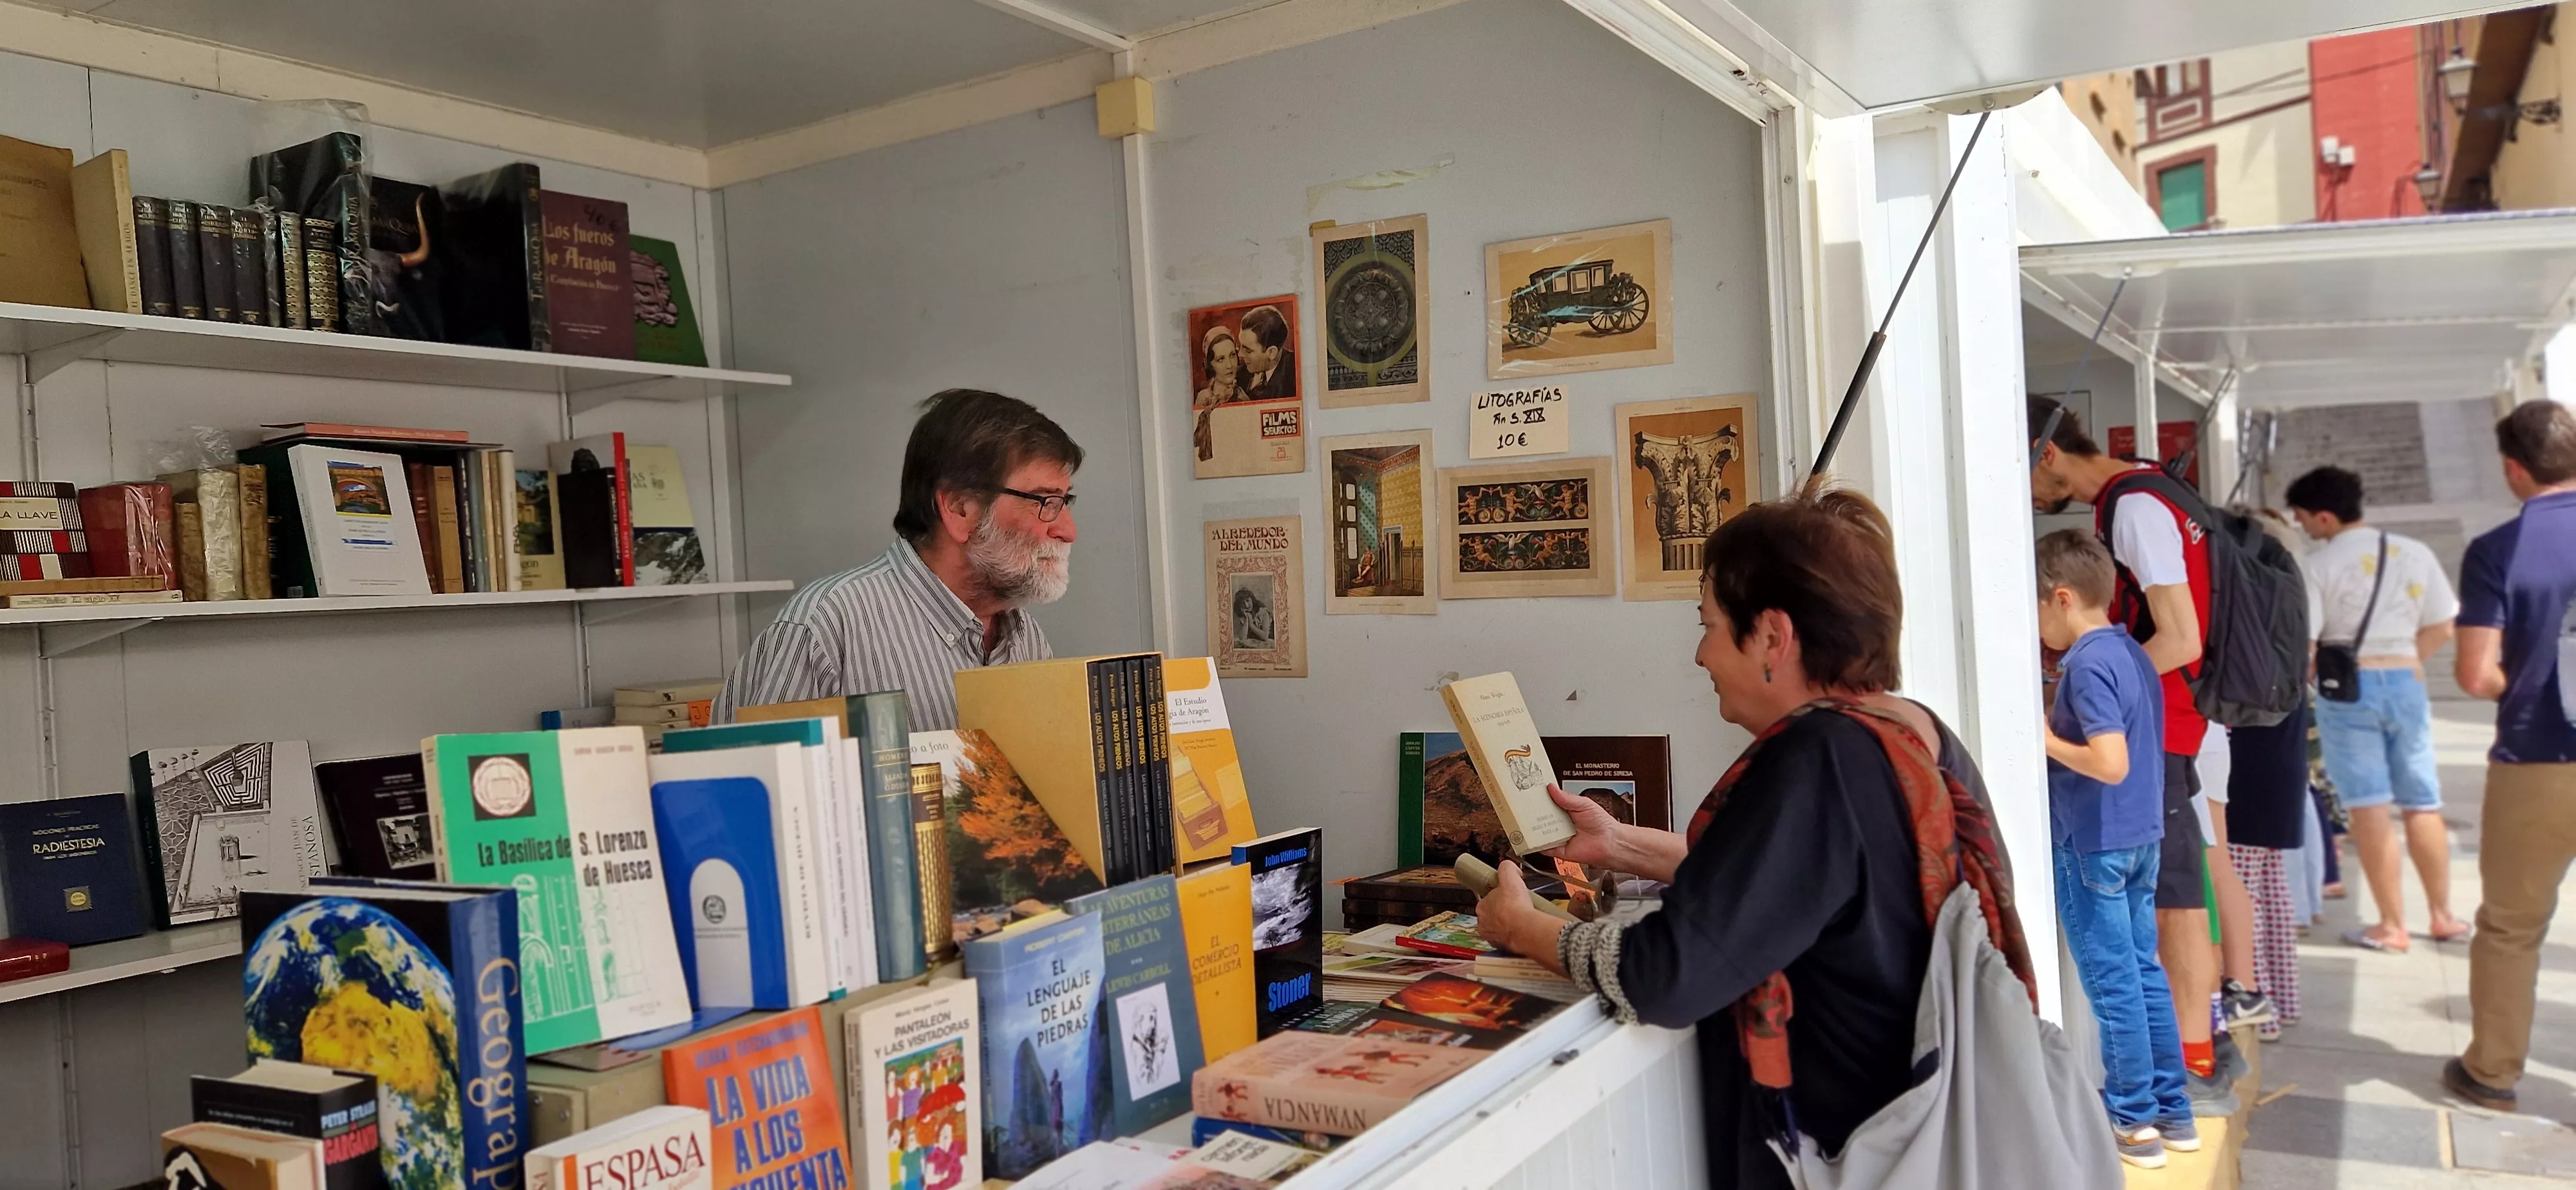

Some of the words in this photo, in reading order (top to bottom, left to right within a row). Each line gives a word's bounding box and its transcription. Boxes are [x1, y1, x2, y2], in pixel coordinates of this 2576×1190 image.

[573, 222, 615, 247] fueros
[563, 246, 616, 276] Aragón
[1263, 411, 1296, 426] FILMS
[1523, 407, 1546, 424] XIX
[1264, 425, 1296, 436] SELECTOS
[17, 511, 59, 520] LLAVE
[1212, 526, 1285, 540] ALREDEDOR
[1184, 696, 1207, 706] Estudio
[1188, 707, 1209, 717] Aragón
[929, 741, 949, 754] foto
[1114, 743, 1122, 770] PIRINEOS
[33, 837, 106, 855] RADIESTESIA
[478, 842, 494, 868] La
[556, 834, 573, 860] de
[579, 832, 592, 856] S.
[596, 829, 649, 855] Lorenzo
[1265, 853, 1280, 867] John
[1280, 847, 1307, 864] Williams
[583, 863, 600, 887] de
[604, 860, 653, 885] Huesca
[1103, 883, 1170, 915] AVENTURAS
[1106, 938, 1122, 956] DE
[1124, 927, 1160, 952] ALICIA
[1210, 934, 1221, 949] EL
[1052, 958, 1066, 977] EL
[1192, 943, 1240, 970] COMERCIO
[1191, 957, 1242, 985] DETALLISTA
[1027, 970, 1091, 1007] LENGUAJE
[1268, 972, 1312, 1013] Stoner
[1041, 1004, 1057, 1024] DE
[1061, 994, 1082, 1016] LAS
[894, 1010, 952, 1037] PANTALEÓN
[1037, 1013, 1088, 1048] PIEDRAS
[874, 1047, 882, 1059] Y
[884, 1039, 905, 1057] LAS
[907, 1018, 970, 1048] VISITADORAS
[706, 1075, 746, 1128] LA
[749, 1054, 813, 1112] VIDA
[321, 1110, 348, 1129] PETER
[734, 1128, 755, 1175] A
[753, 1108, 805, 1165] LOS
[584, 1131, 706, 1190] ESPASA
